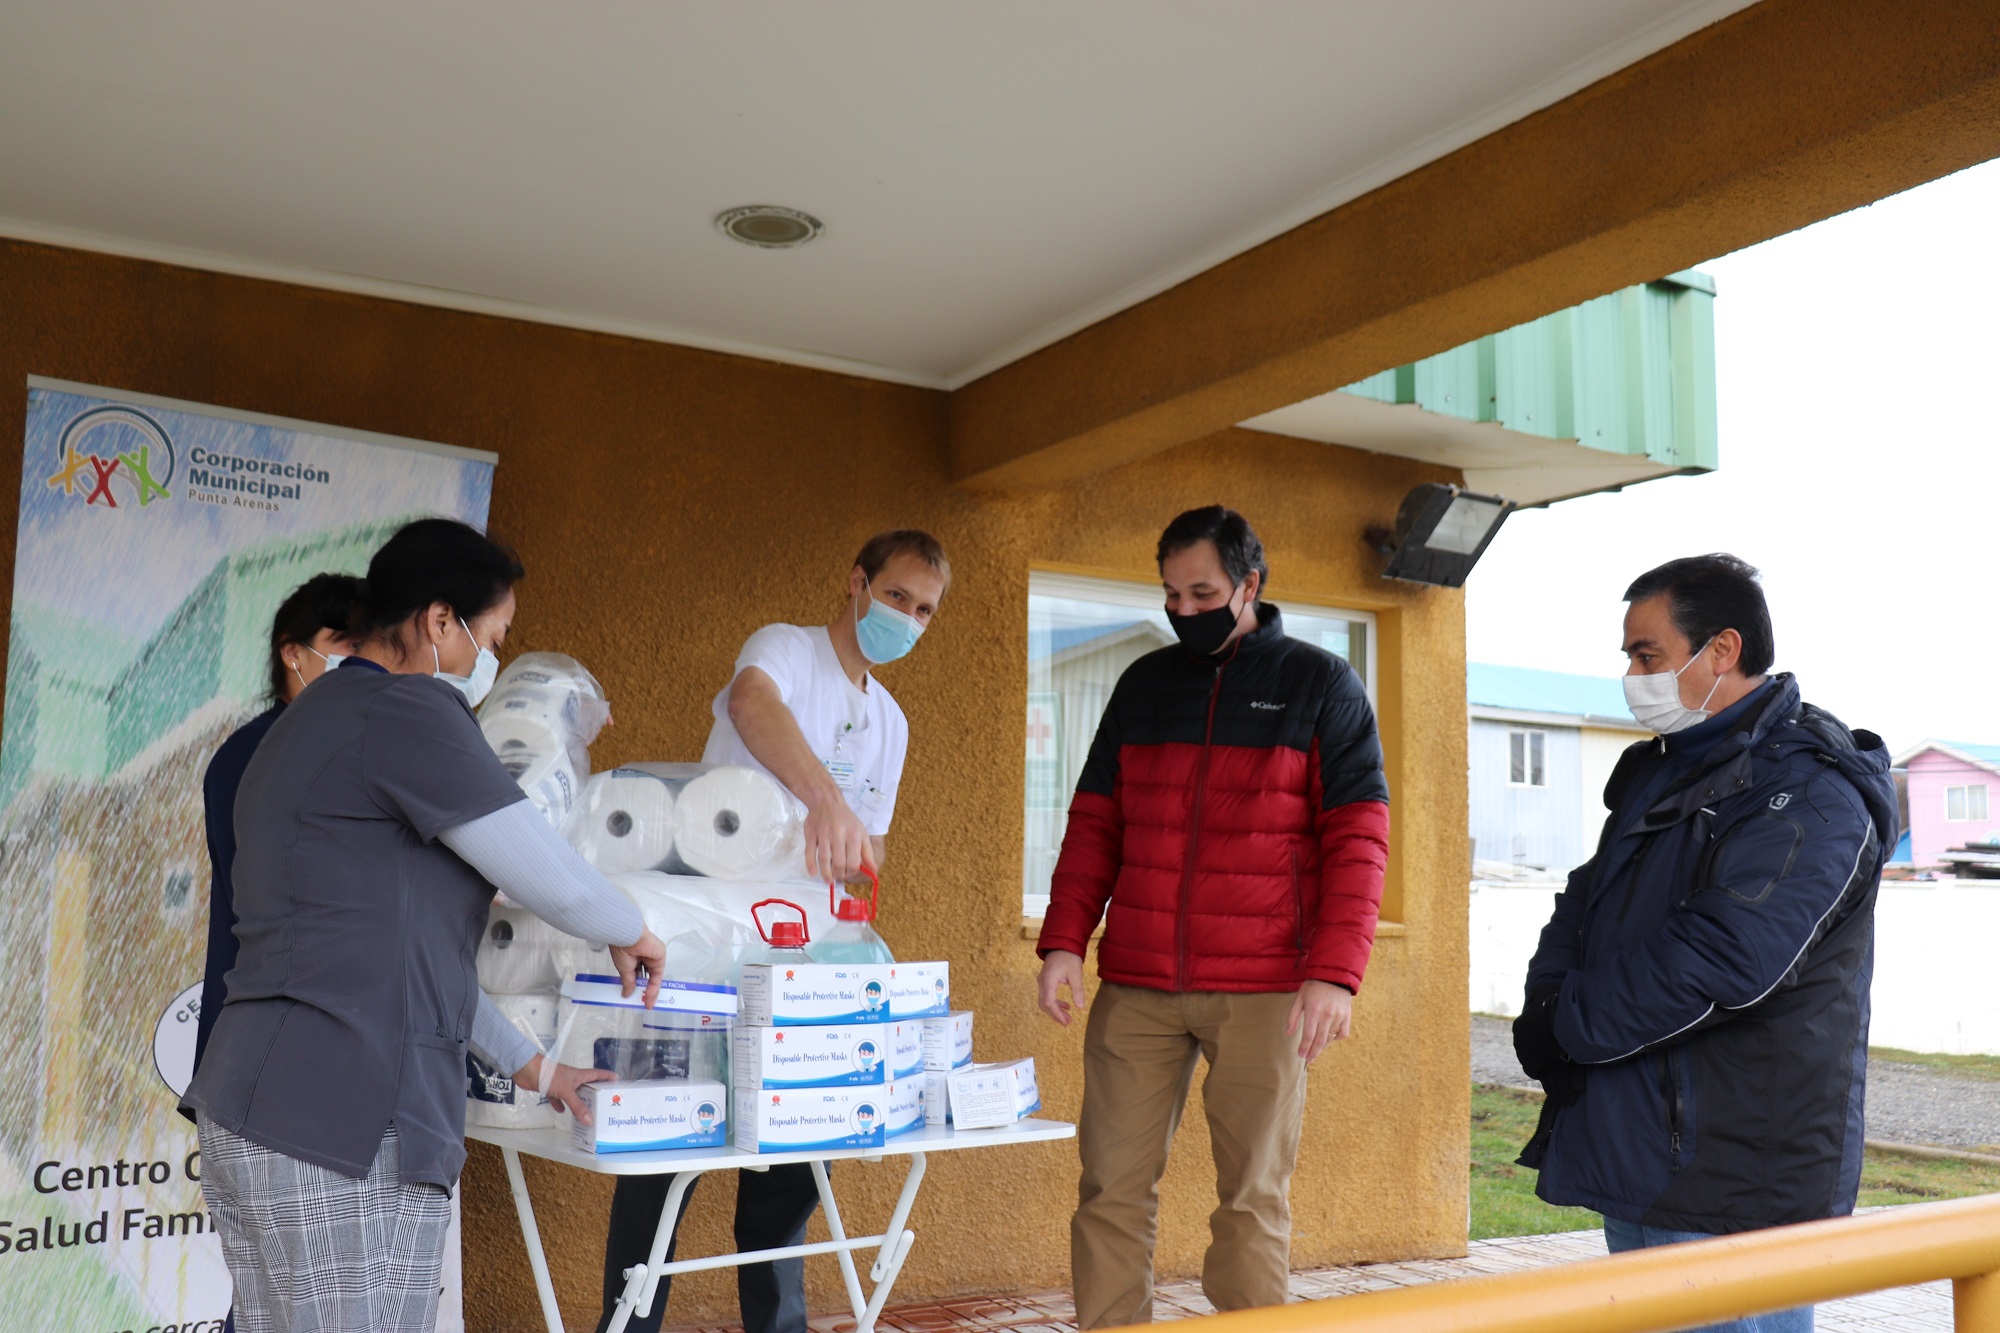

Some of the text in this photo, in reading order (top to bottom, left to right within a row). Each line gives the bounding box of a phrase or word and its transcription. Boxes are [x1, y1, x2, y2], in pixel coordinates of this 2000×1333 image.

[190, 447, 330, 483] Corporación
[188, 468, 301, 500] Municipal
[188, 489, 280, 512] Punta Arenas
[668, 981, 687, 990] FACIAL
[783, 990, 855, 1002] Disposable Protective Masks
[176, 999, 201, 1023] CE
[773, 1052, 847, 1066] Disposable Protective Masks
[608, 1115, 686, 1128] Disposable Protective Masks
[769, 1114, 845, 1128] Disposable Protective Masks
[33, 1158, 171, 1193] Centro
[0, 1211, 108, 1254] Salud
[146, 1318, 225, 1333] erca
